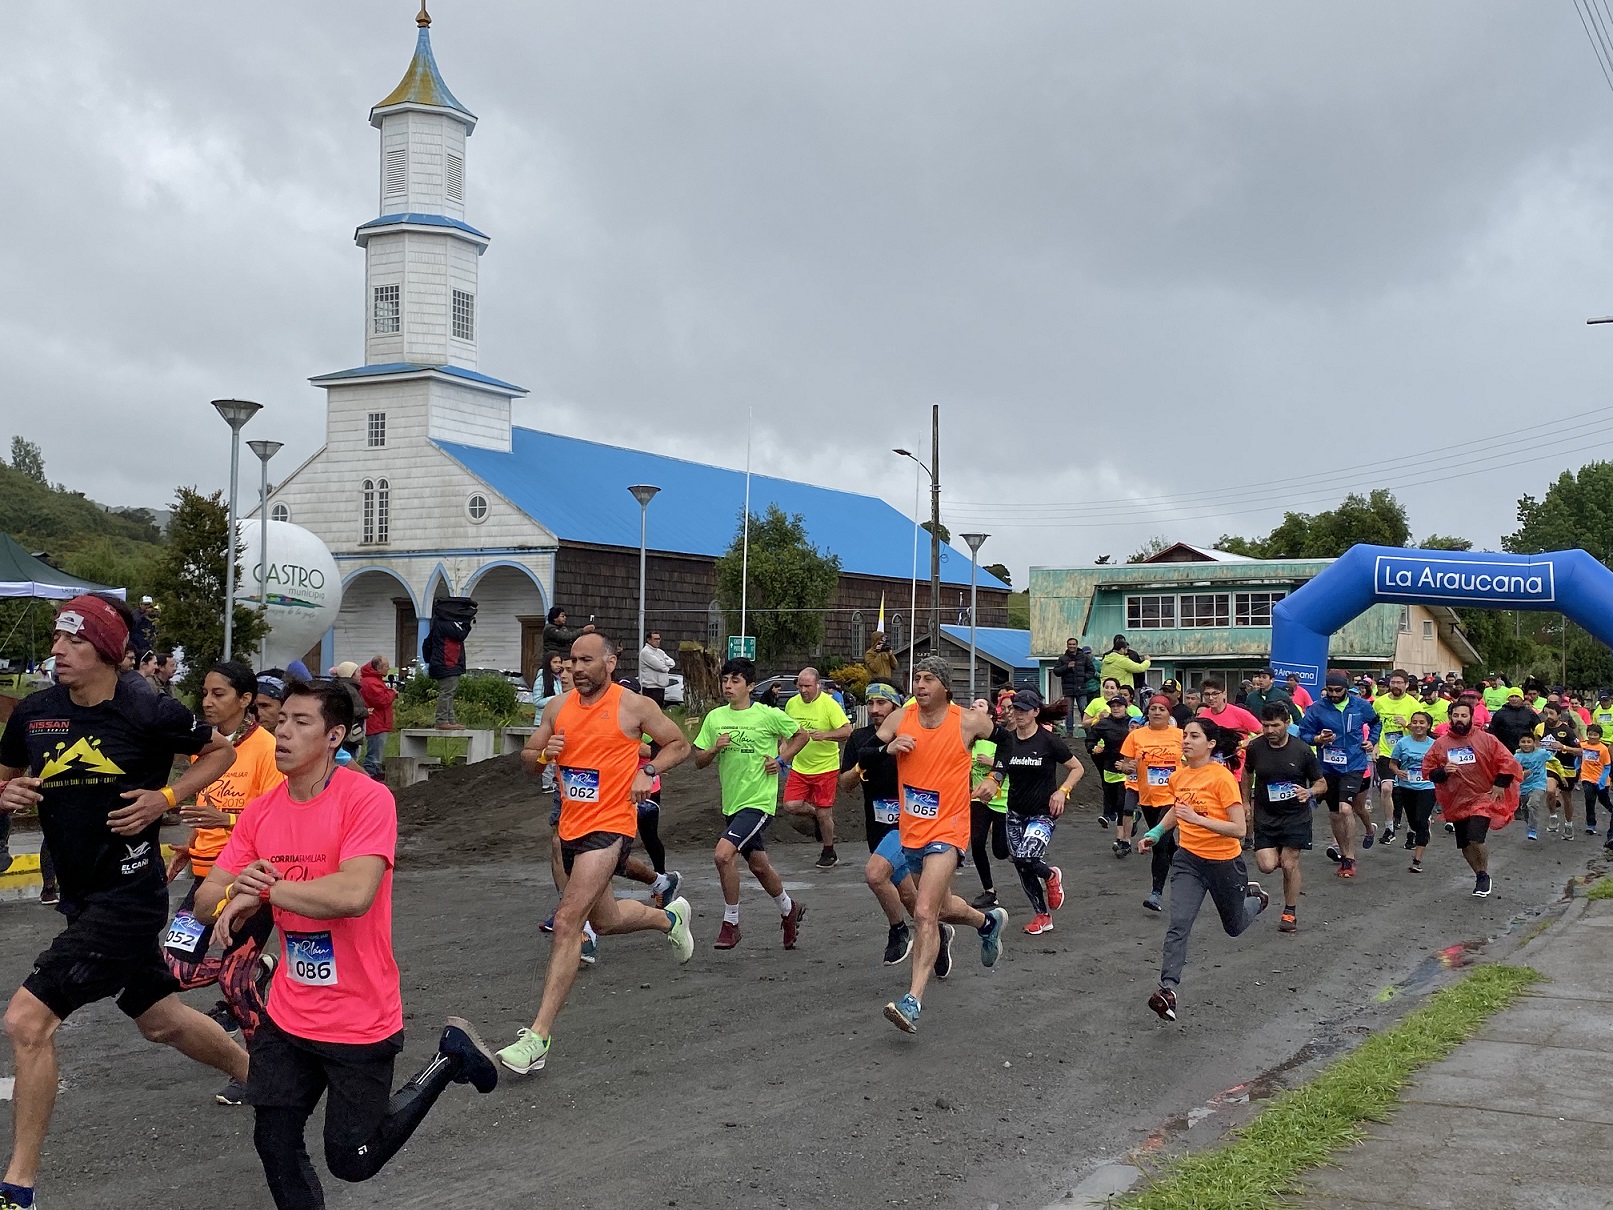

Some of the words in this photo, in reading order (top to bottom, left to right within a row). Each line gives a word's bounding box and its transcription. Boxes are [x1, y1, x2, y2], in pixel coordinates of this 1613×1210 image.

[253, 563, 325, 590] CASTRO
[1385, 565, 1412, 588] La
[1417, 566, 1543, 594] Araucana
[29, 721, 70, 730] NISSAN
[1459, 754, 1474, 762] 149
[208, 779, 246, 803] Rilán
[570, 786, 596, 799] 062
[222, 798, 245, 807] 2019
[913, 804, 937, 816] 065
[165, 930, 196, 947] 052
[300, 940, 330, 960] Rilán
[296, 960, 331, 980] 086
